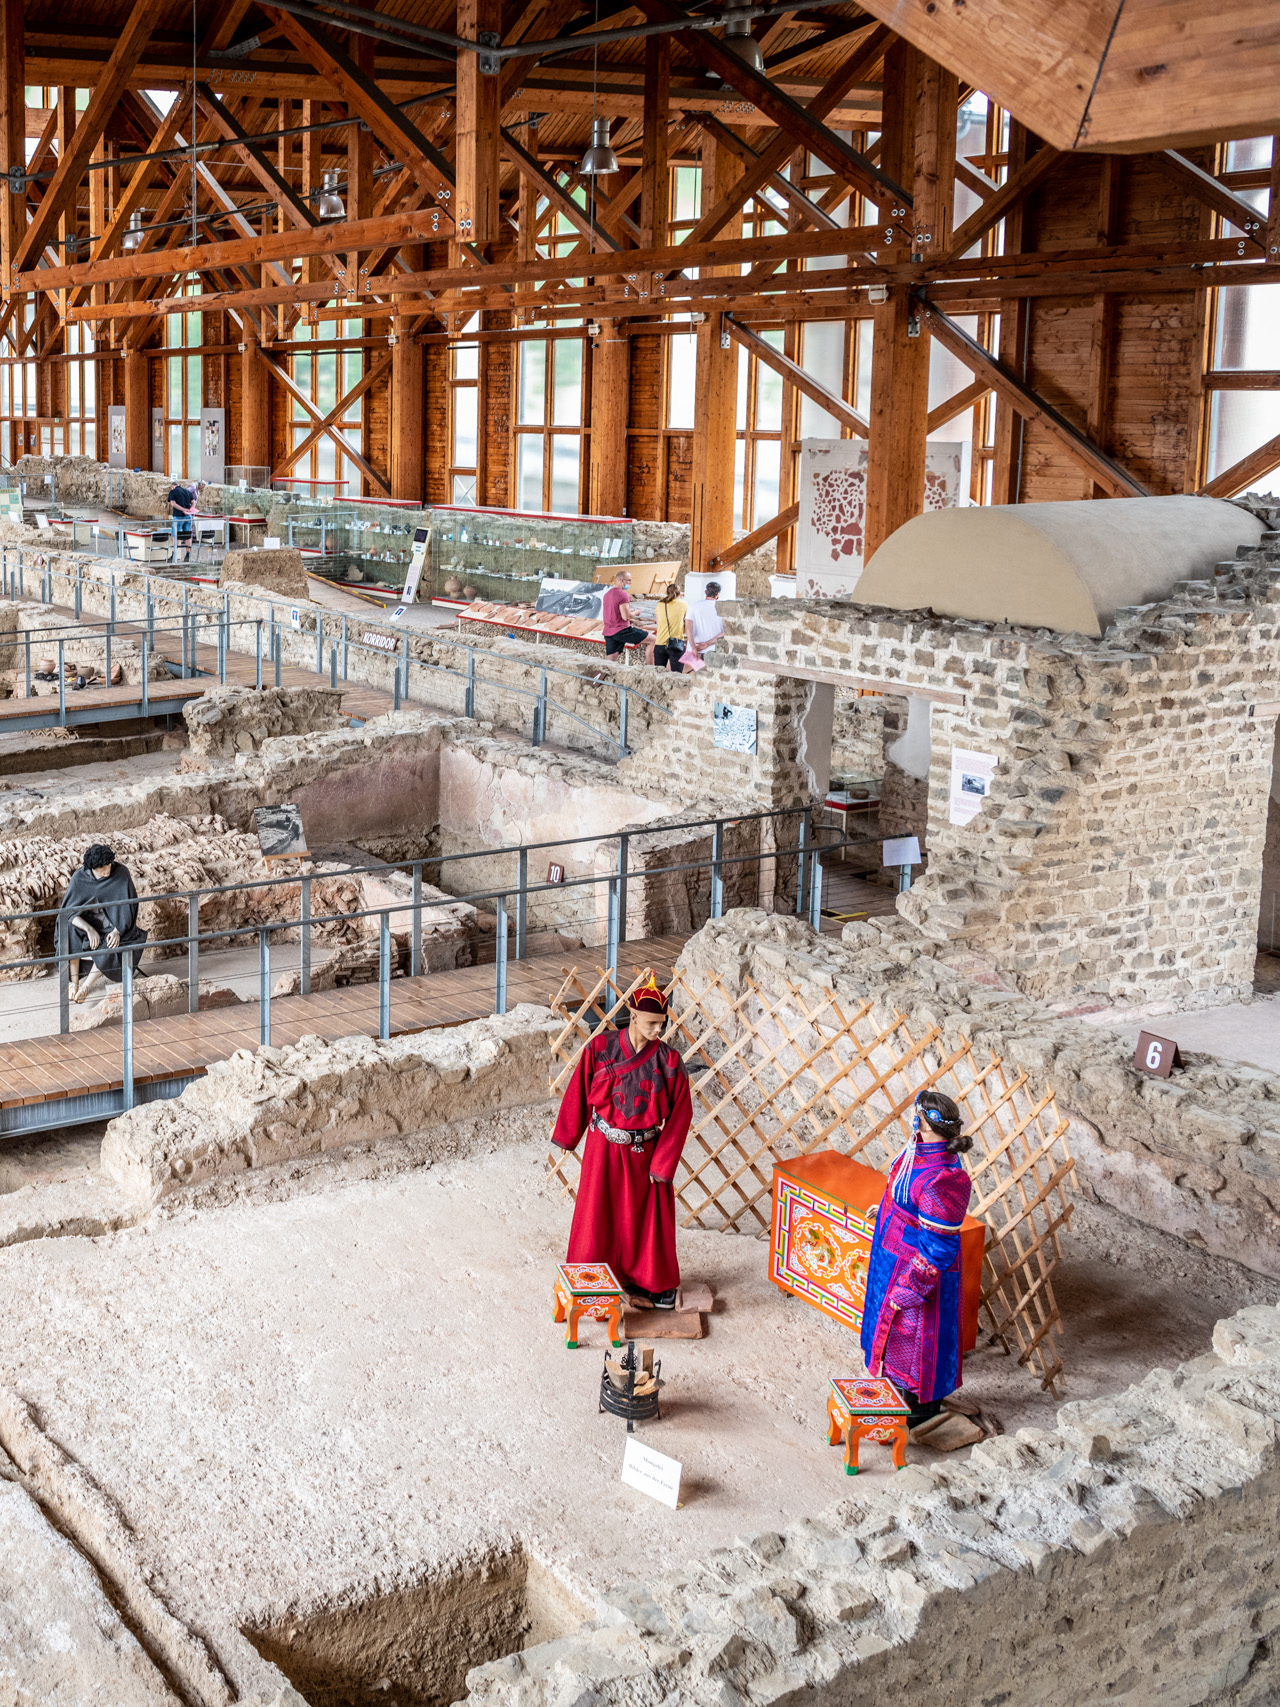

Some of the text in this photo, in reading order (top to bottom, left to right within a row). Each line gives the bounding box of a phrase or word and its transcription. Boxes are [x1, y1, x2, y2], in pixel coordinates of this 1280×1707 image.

[362, 631, 396, 650] KORRIDOR
[549, 865, 561, 883] 10
[1145, 1041, 1163, 1069] 6
